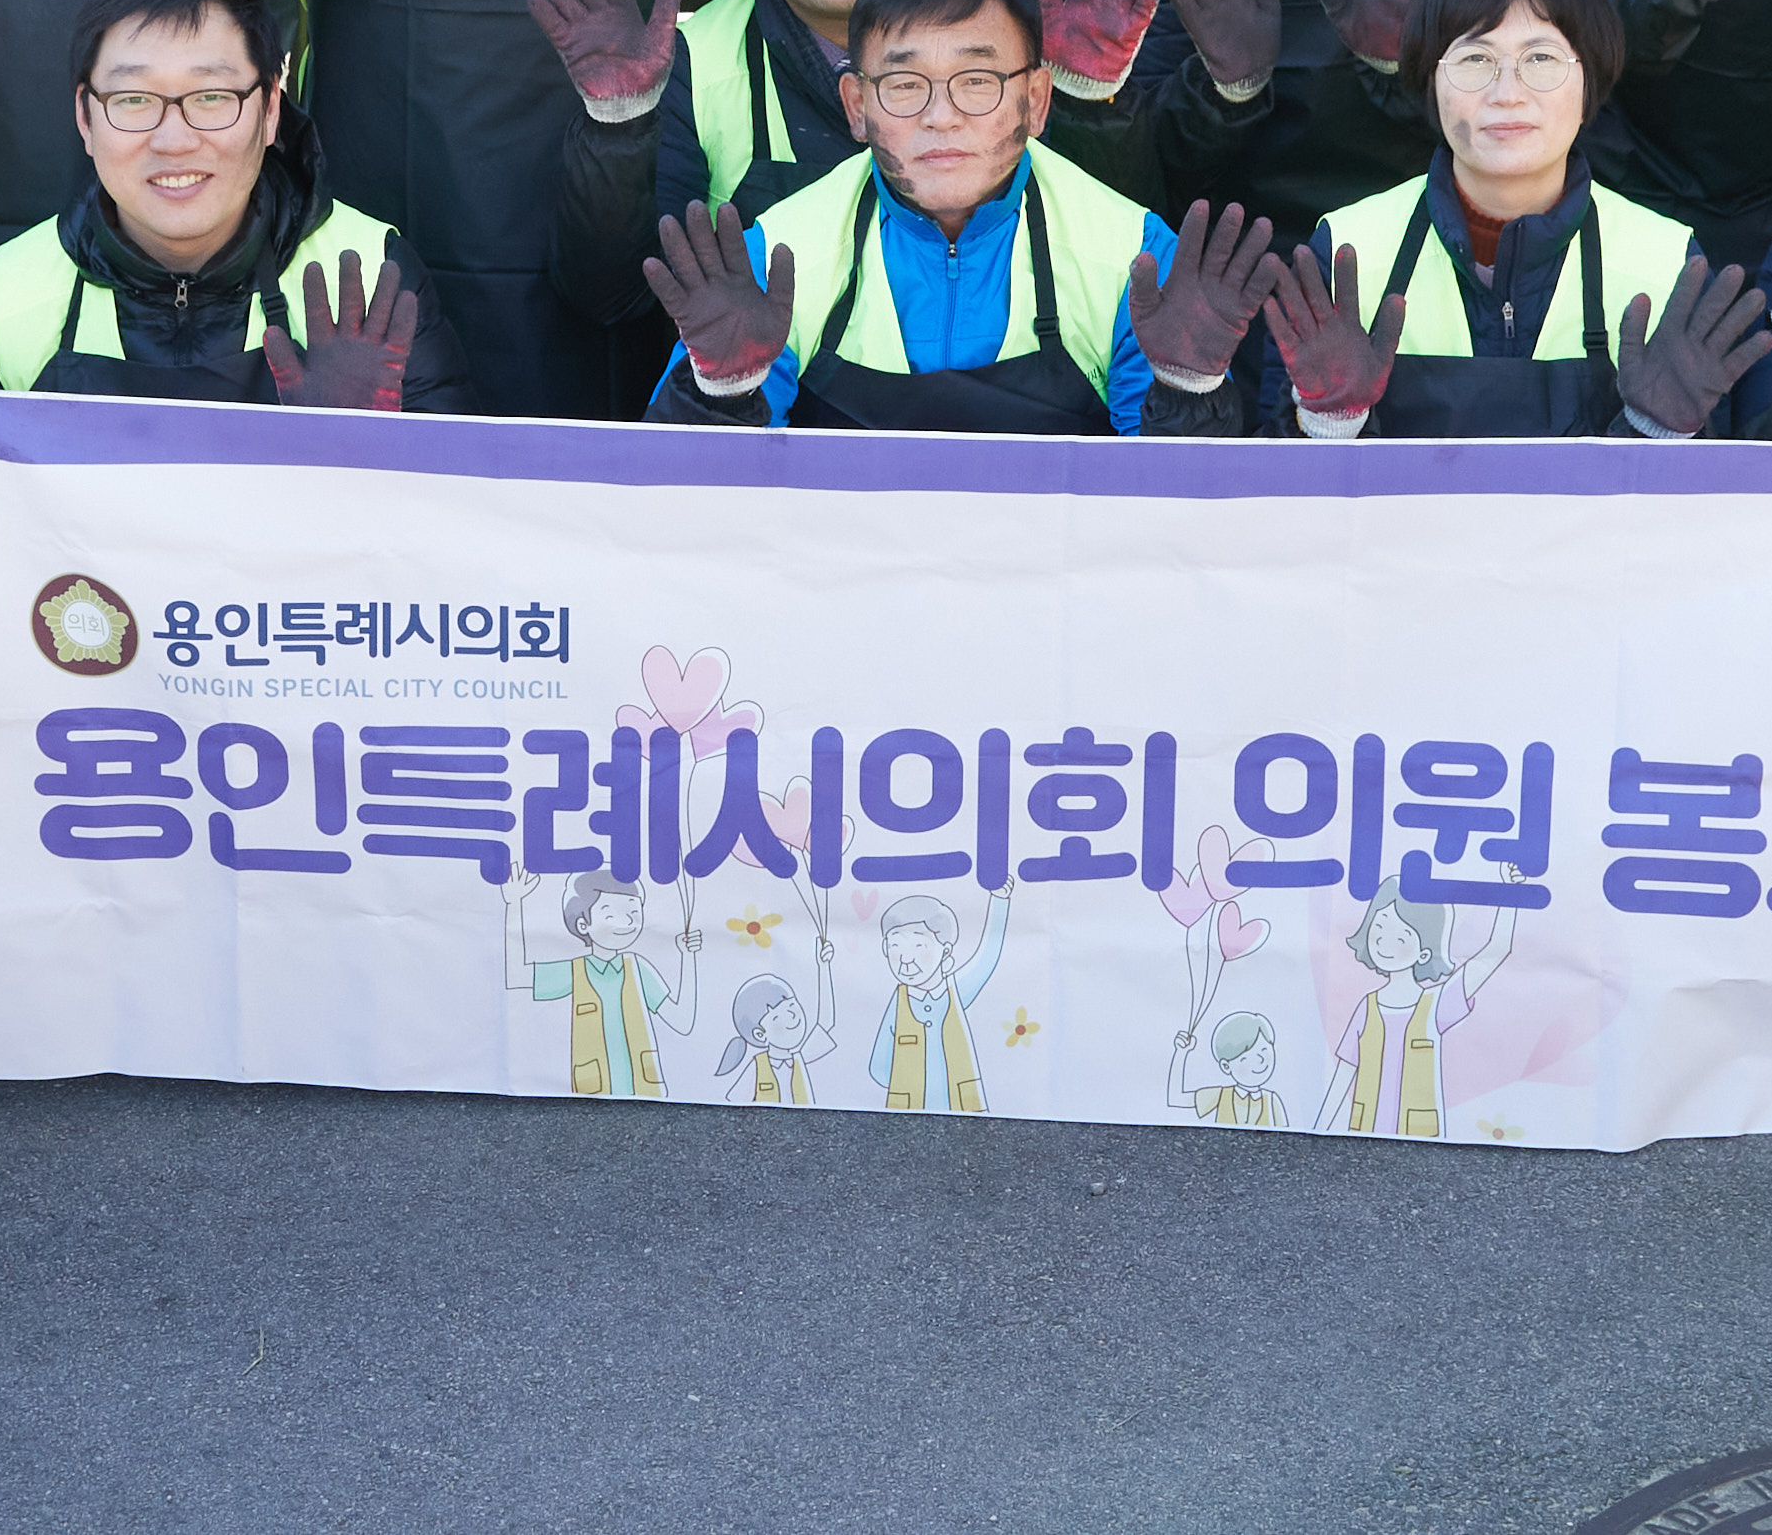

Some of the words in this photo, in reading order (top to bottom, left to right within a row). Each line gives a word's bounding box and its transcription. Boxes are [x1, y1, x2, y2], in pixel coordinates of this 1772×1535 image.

[67, 613, 105, 636] 의회
[153, 600, 569, 667] 용인특례시의회
[158, 673, 254, 698] YONGIN
[264, 677, 374, 699] SPECIAL
[384, 678, 444, 699] CITY
[453, 678, 569, 700] COUNCIL
[33, 707, 1178, 893] 용인특례시의회
[1224, 727, 1555, 911] 의원
